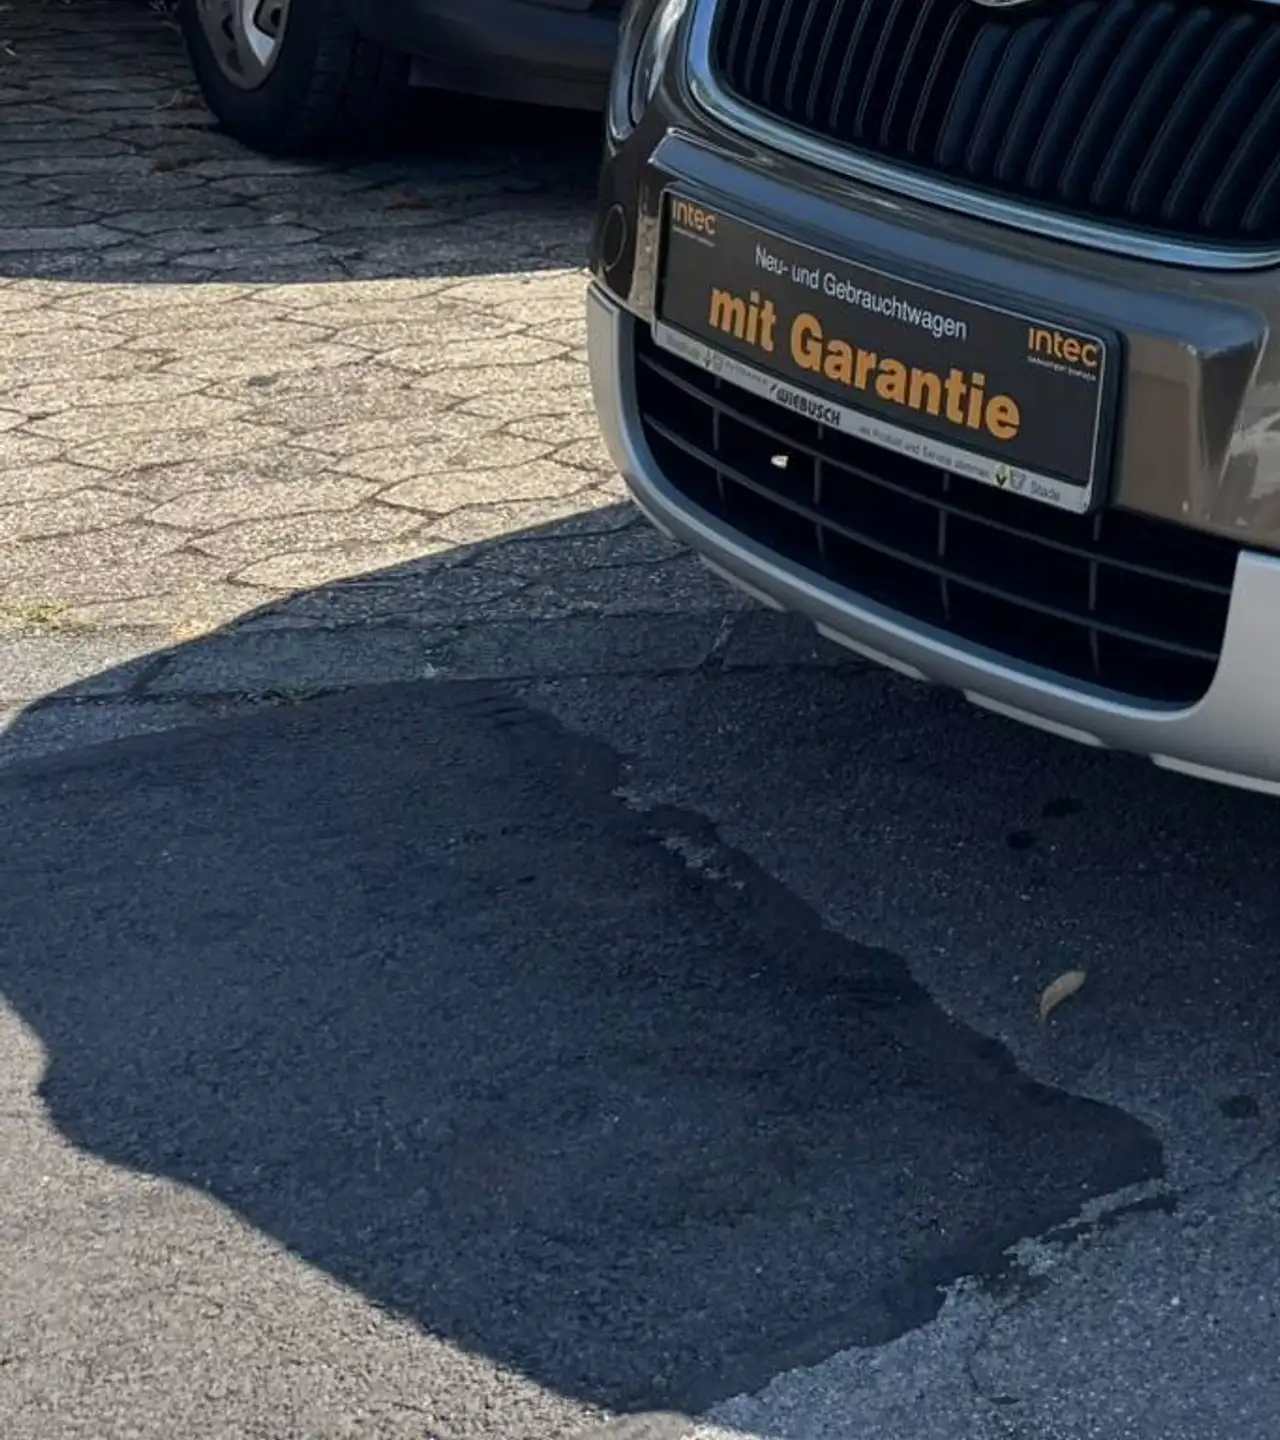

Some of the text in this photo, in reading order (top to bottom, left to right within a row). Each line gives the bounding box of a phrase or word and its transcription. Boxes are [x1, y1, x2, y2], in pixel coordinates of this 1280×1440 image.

[755, 243, 967, 342] Neu- und Gebrauchtwagen
[709, 287, 1020, 440] mit Garantie
